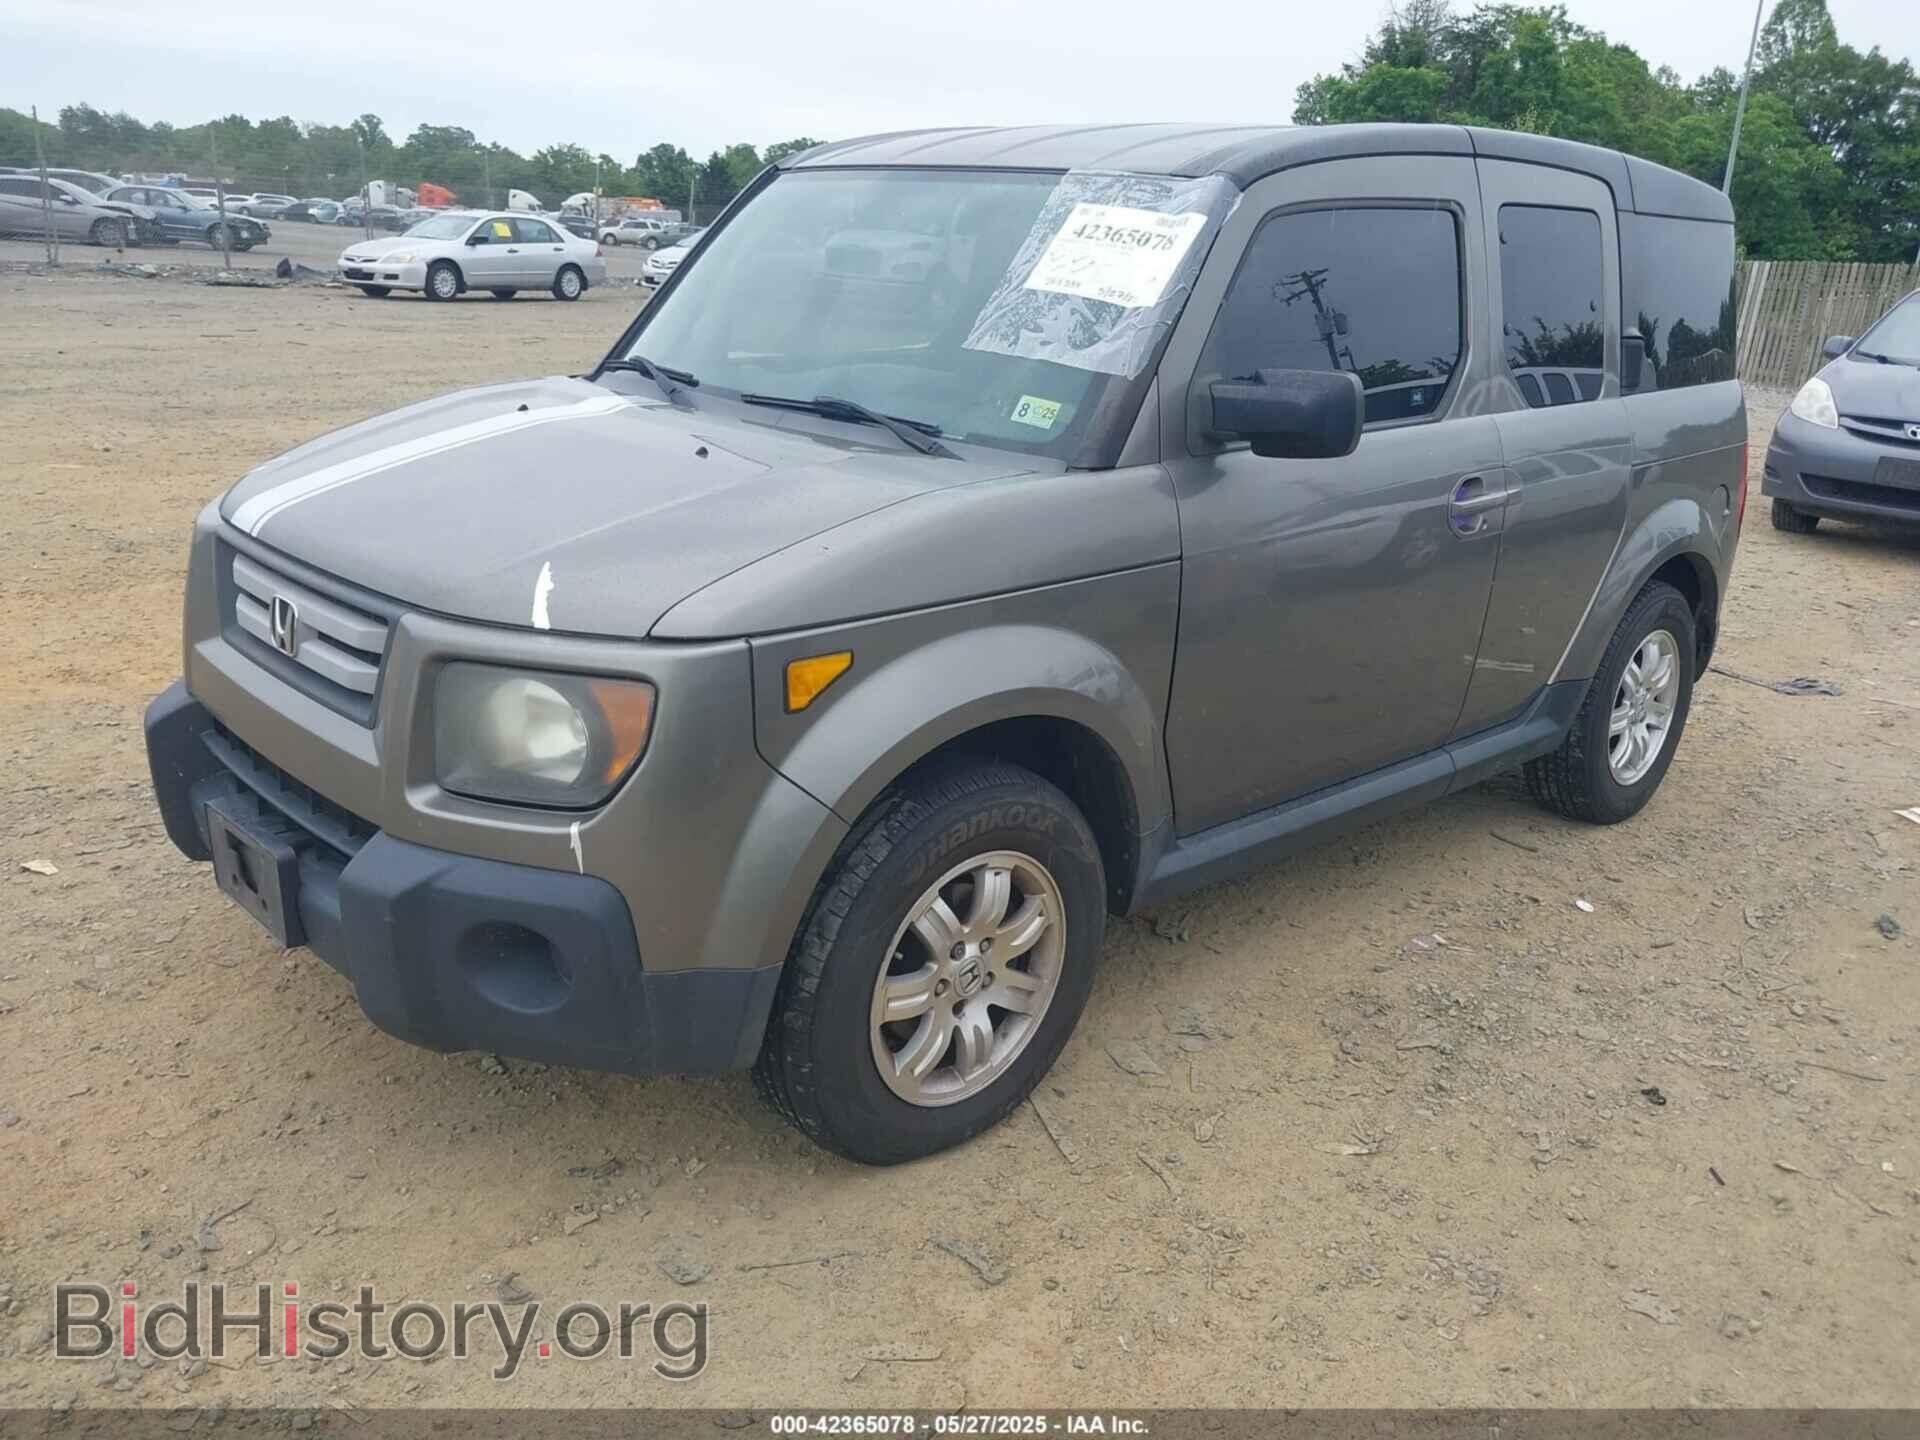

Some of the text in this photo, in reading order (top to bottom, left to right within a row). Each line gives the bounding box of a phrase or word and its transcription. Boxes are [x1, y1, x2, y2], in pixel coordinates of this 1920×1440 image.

[1073, 223, 1178, 251] 42365078
[1018, 402, 1057, 420] 8 25
